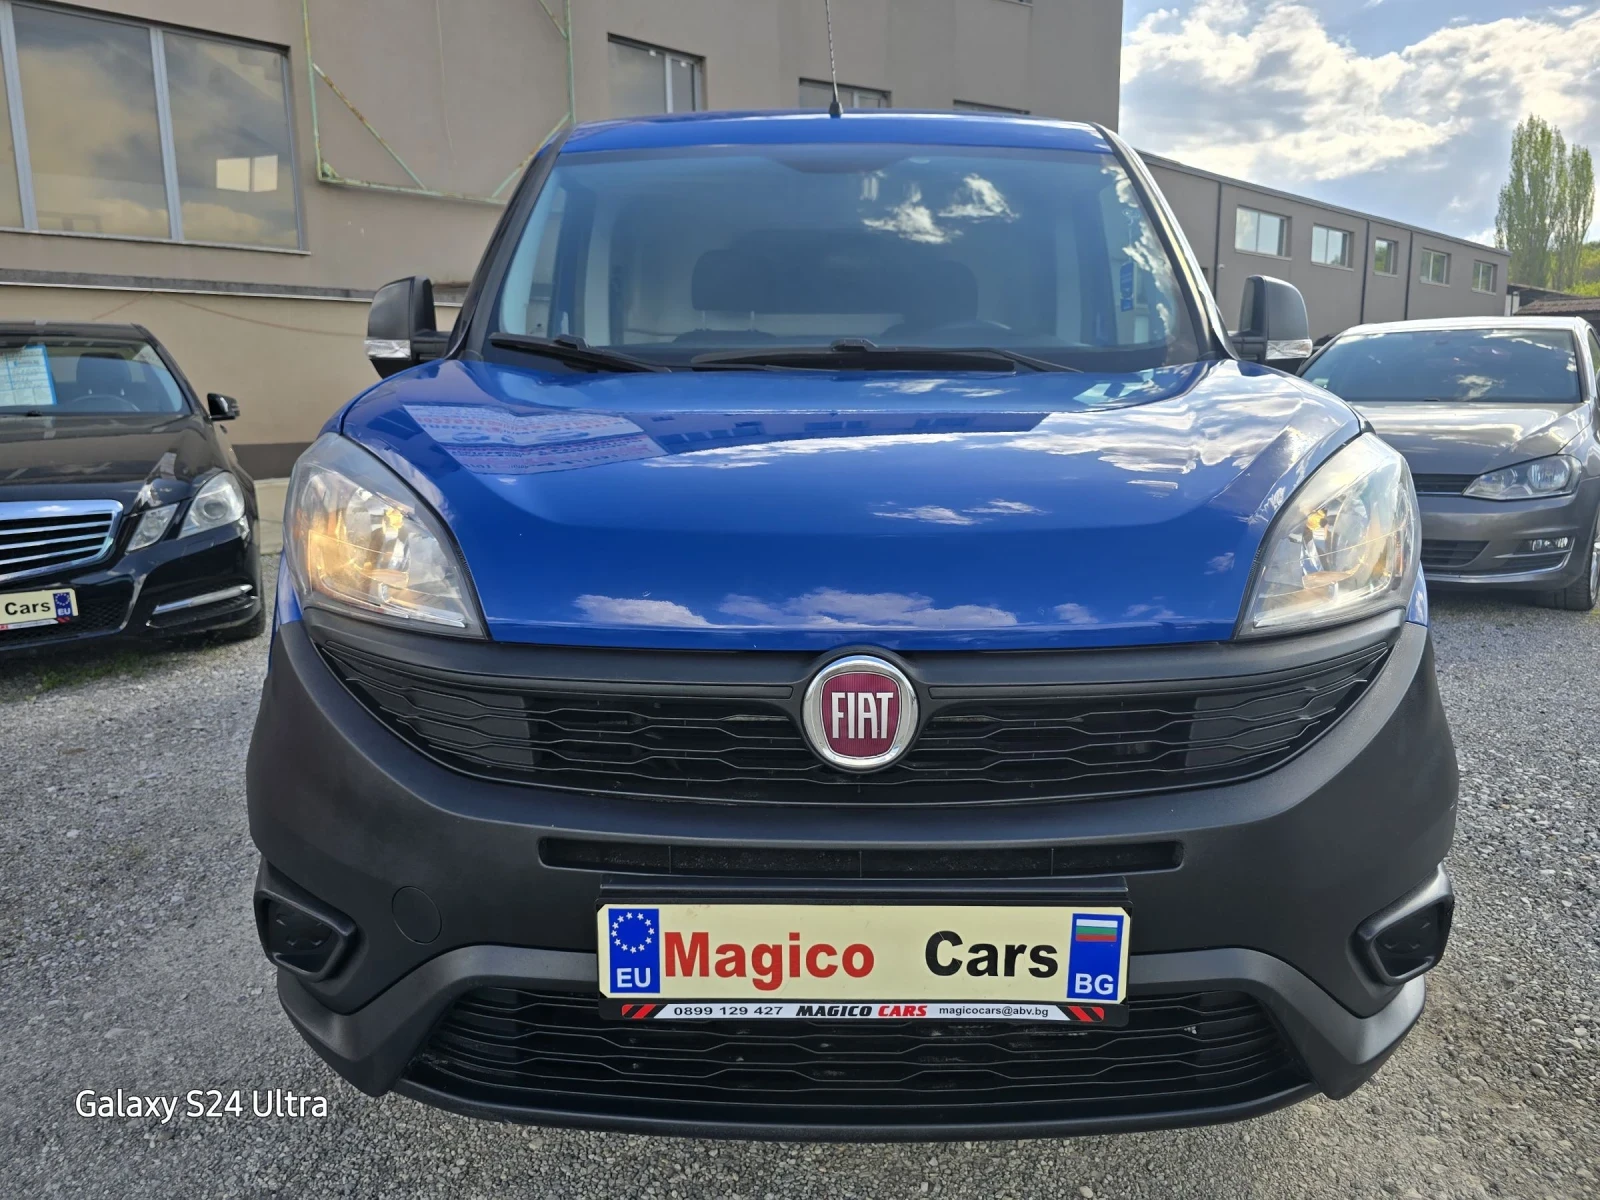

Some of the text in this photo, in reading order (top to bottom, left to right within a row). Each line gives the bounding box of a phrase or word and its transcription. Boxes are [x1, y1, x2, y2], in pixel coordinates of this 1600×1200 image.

[5, 602, 51, 615] Cars
[57, 607, 71, 616] EU
[831, 692, 894, 739] FIAT
[664, 930, 1059, 991] Magico Cars
[617, 967, 652, 988] EU
[1075, 973, 1114, 995] BG
[674, 1006, 783, 1016] 0899 129 427
[796, 1005, 928, 1017] MAGICO CARS
[939, 1005, 1049, 1018] magicocars@abv.bg
